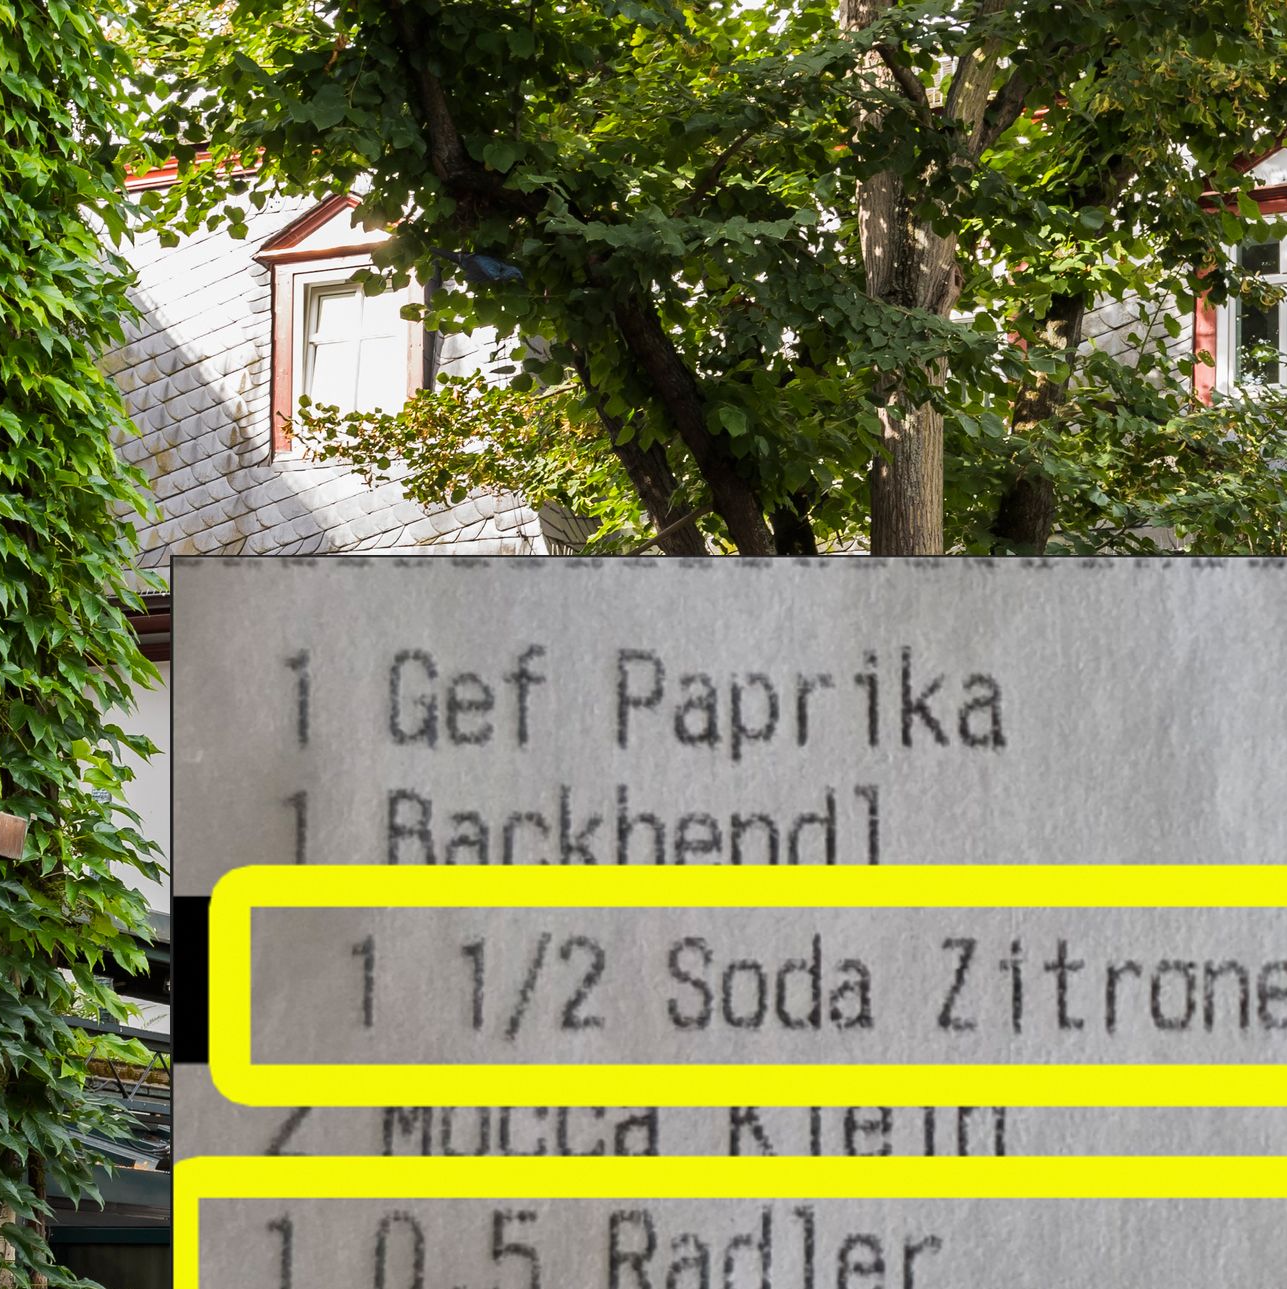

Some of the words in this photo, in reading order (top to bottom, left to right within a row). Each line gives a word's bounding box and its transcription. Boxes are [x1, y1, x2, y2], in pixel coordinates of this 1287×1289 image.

[282, 650, 308, 748] 1
[389, 646, 545, 747] Gef
[617, 646, 1006, 762] Paprika
[280, 789, 308, 865] 1
[352, 933, 374, 1030] 1
[461, 934, 604, 1040] 1/2
[668, 934, 873, 1030] Soda
